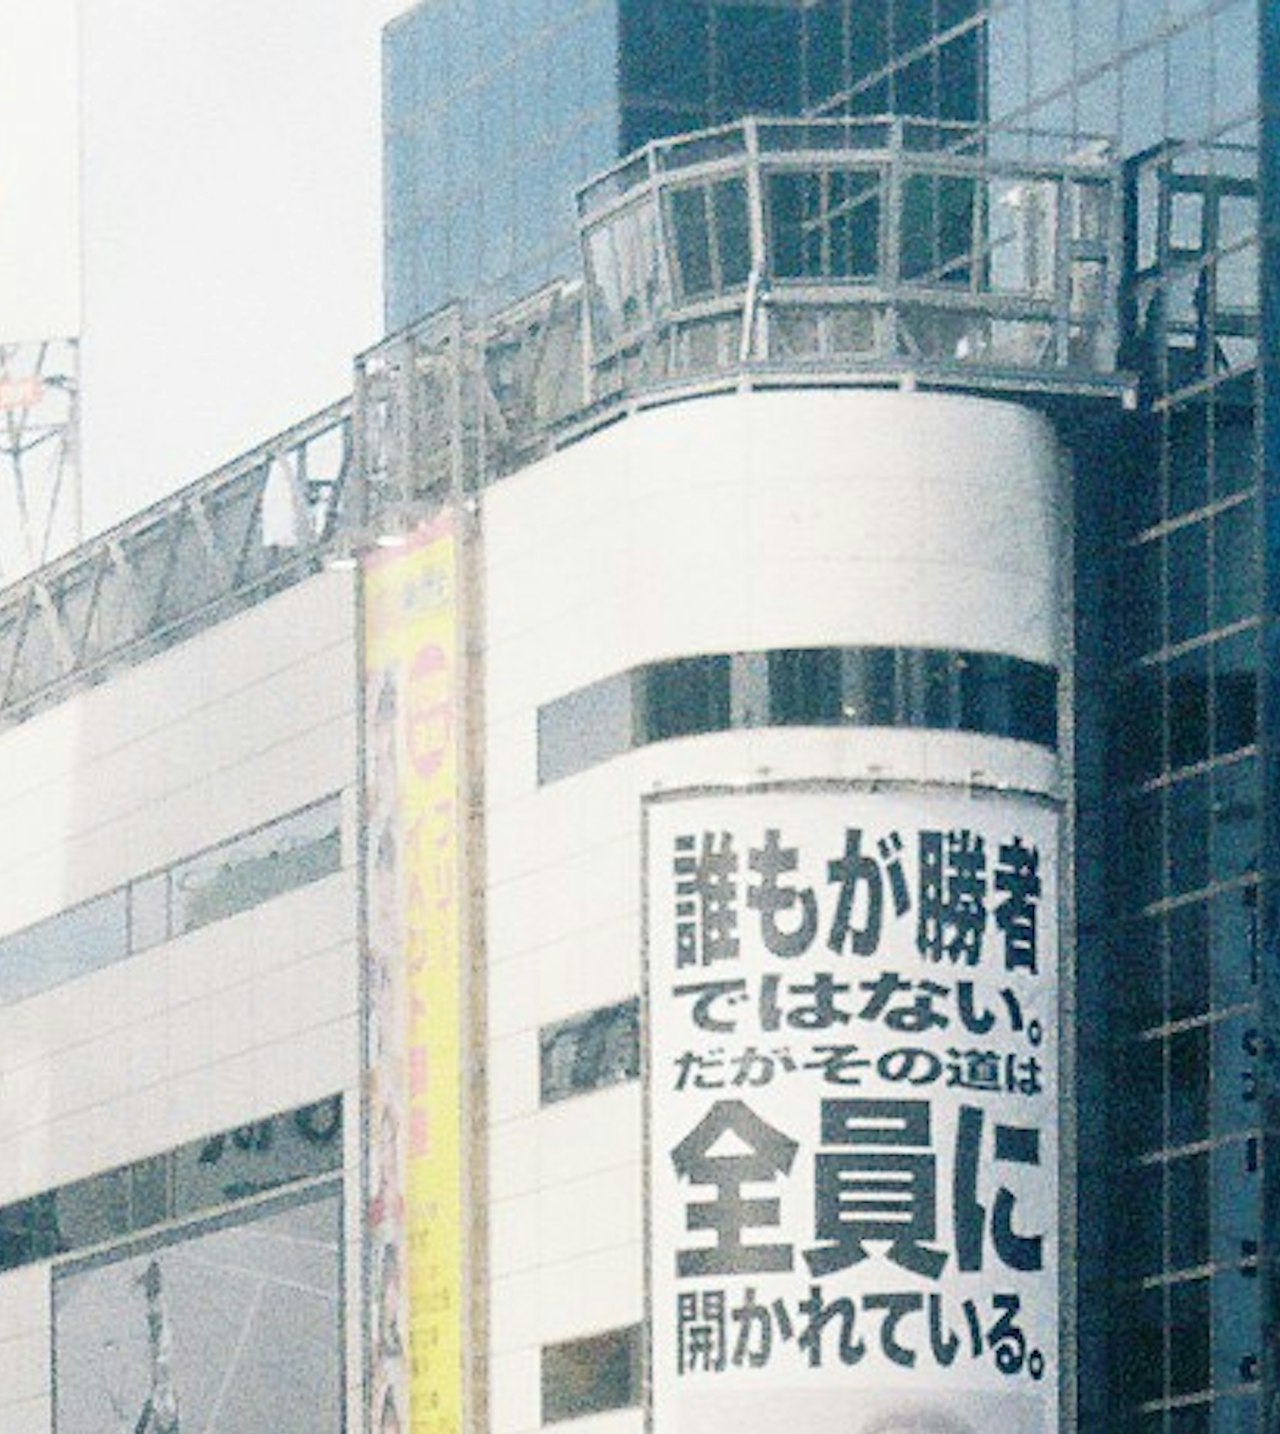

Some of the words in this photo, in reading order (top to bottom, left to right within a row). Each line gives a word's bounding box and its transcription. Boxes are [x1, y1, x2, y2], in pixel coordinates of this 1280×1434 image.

[674, 827, 1040, 974] 誰もが勝者
[672, 971, 1043, 1047] ではない。
[672, 1043, 1043, 1096] だがその道は
[669, 1098, 1045, 1281] 全員に
[675, 1286, 1045, 1381] 開かれている。
